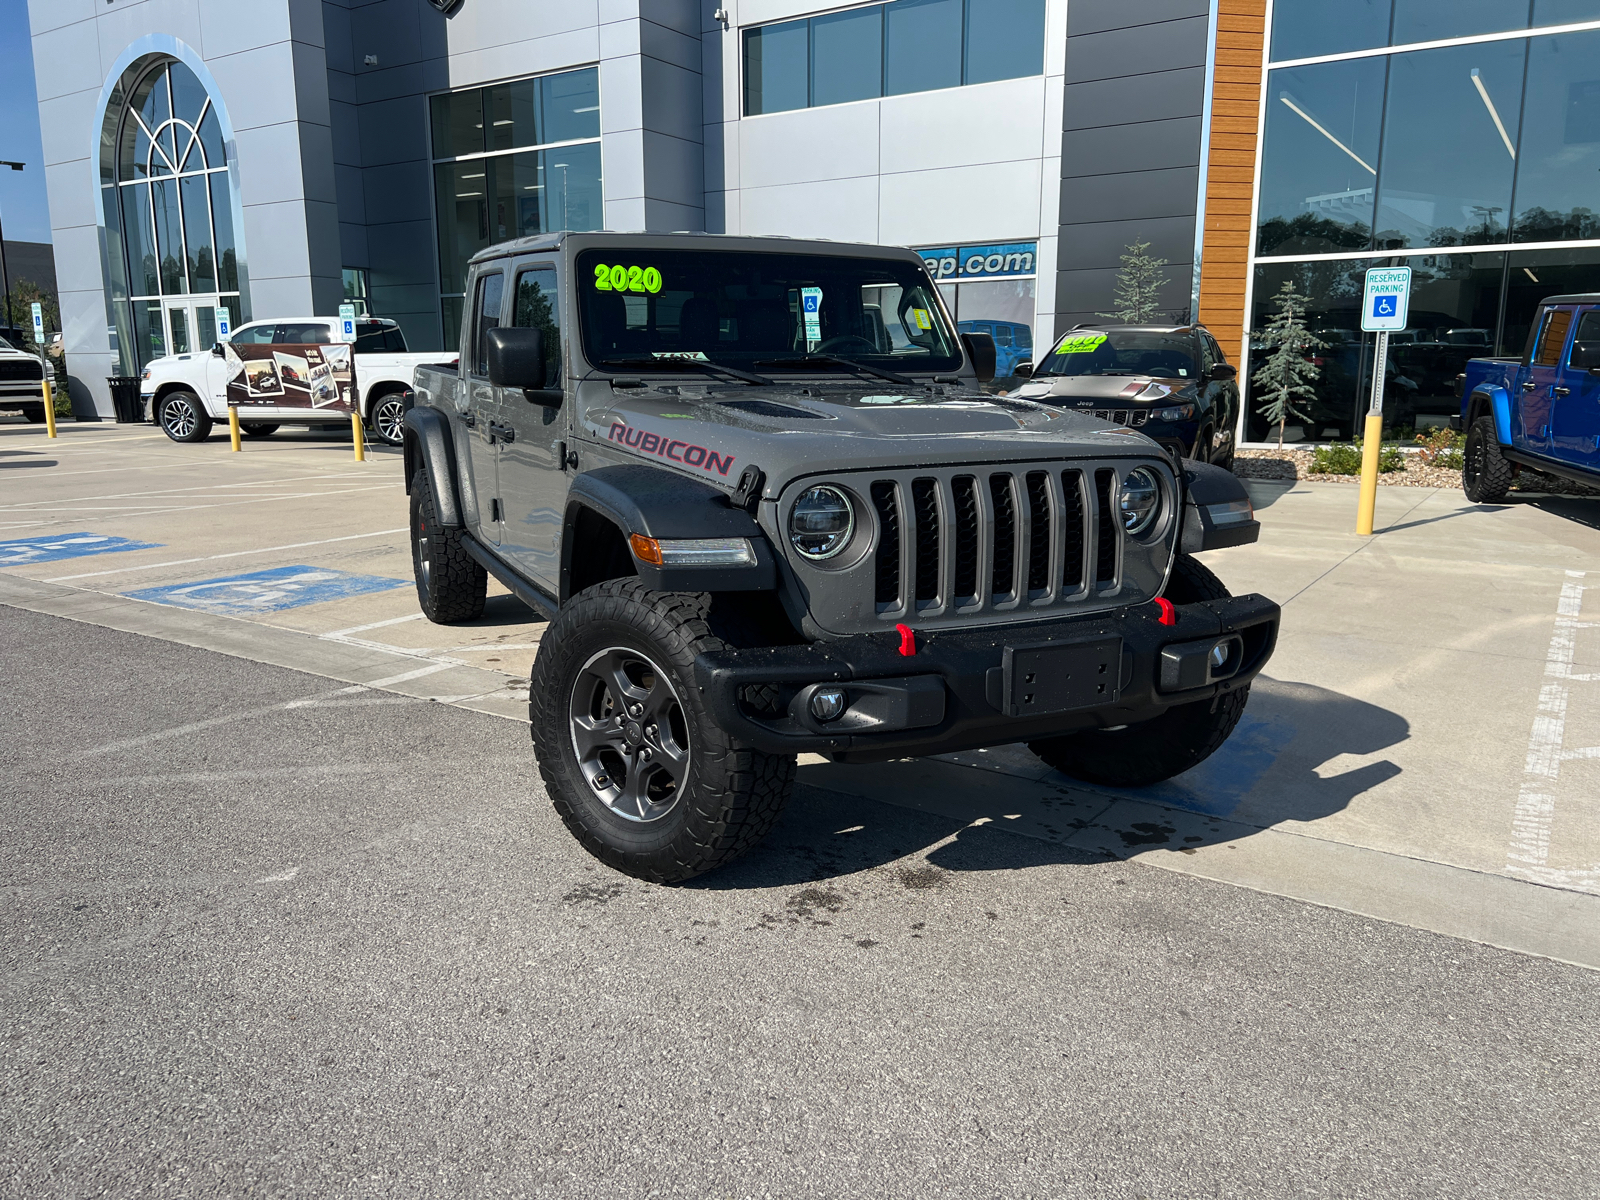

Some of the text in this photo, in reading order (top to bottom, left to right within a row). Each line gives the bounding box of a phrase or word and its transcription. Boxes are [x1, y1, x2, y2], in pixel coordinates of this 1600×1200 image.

[594, 264, 662, 293] 2020
[1369, 273, 1407, 282] RESERVED
[1370, 284, 1403, 293] PARKING
[608, 422, 736, 477] RUBICON
